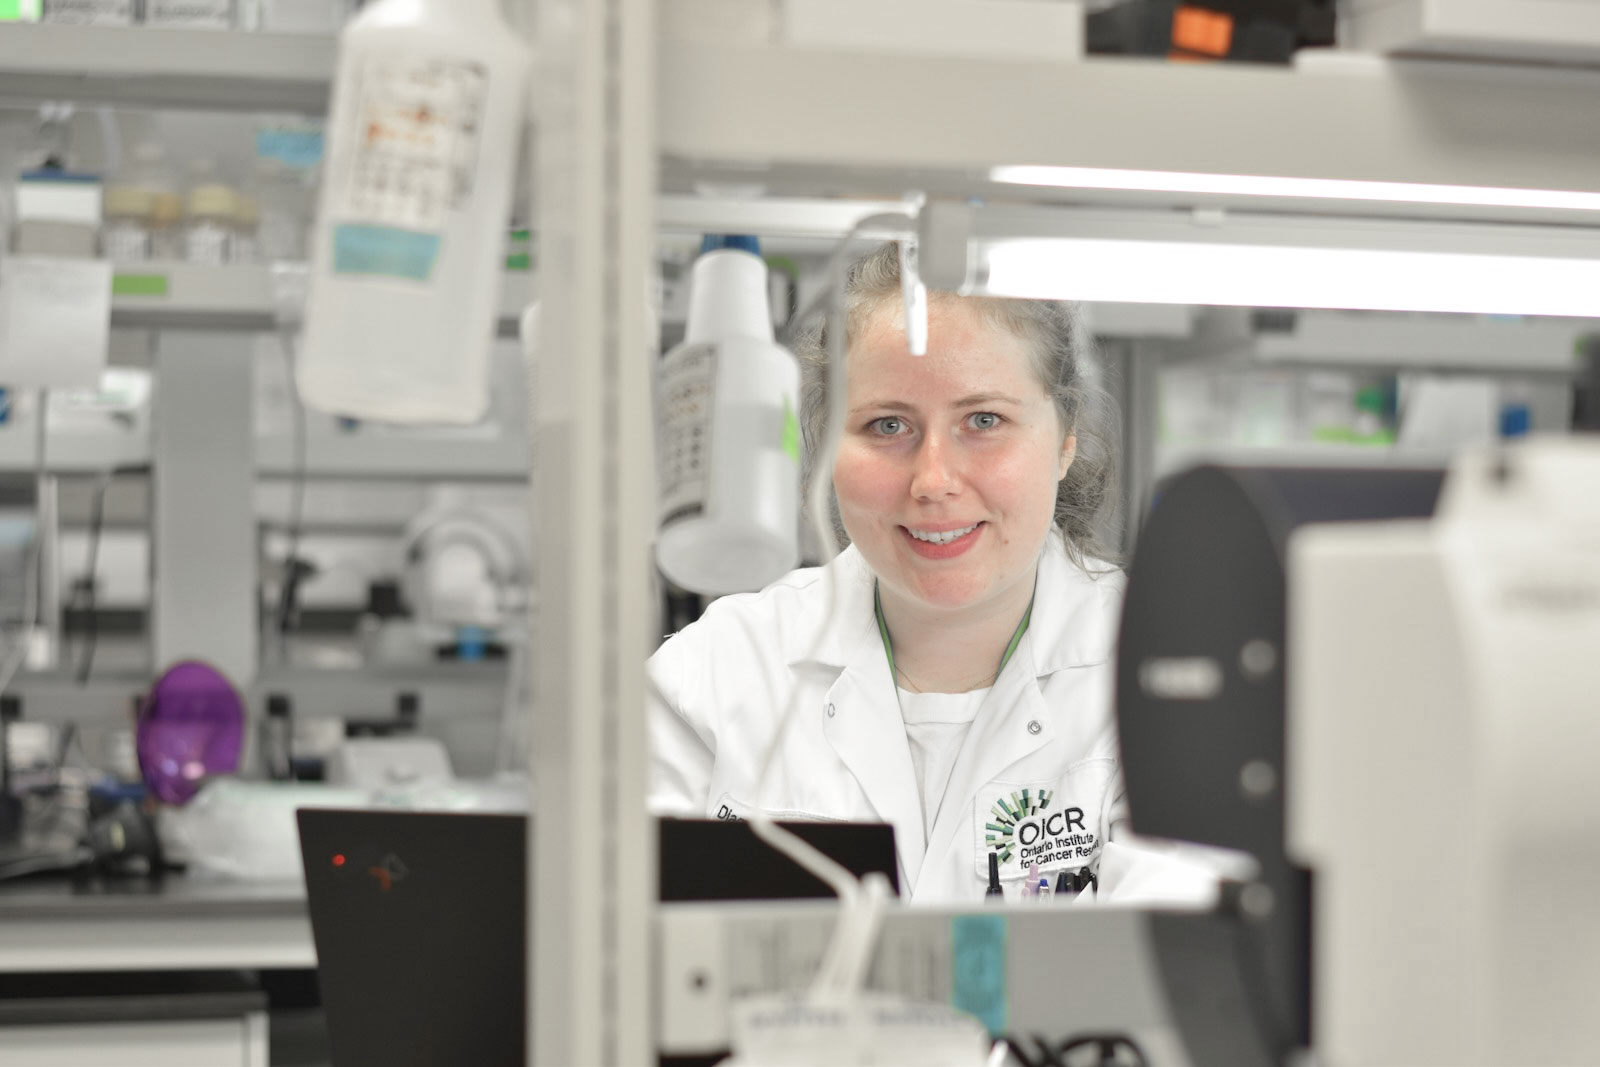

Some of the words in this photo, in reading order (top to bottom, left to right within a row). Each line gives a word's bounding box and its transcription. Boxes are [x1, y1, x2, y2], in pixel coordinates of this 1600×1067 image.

[1019, 807, 1086, 845] OICR
[1020, 840, 1053, 859] Ontario
[1055, 833, 1094, 848] Institute
[1035, 849, 1073, 865] Cancer
